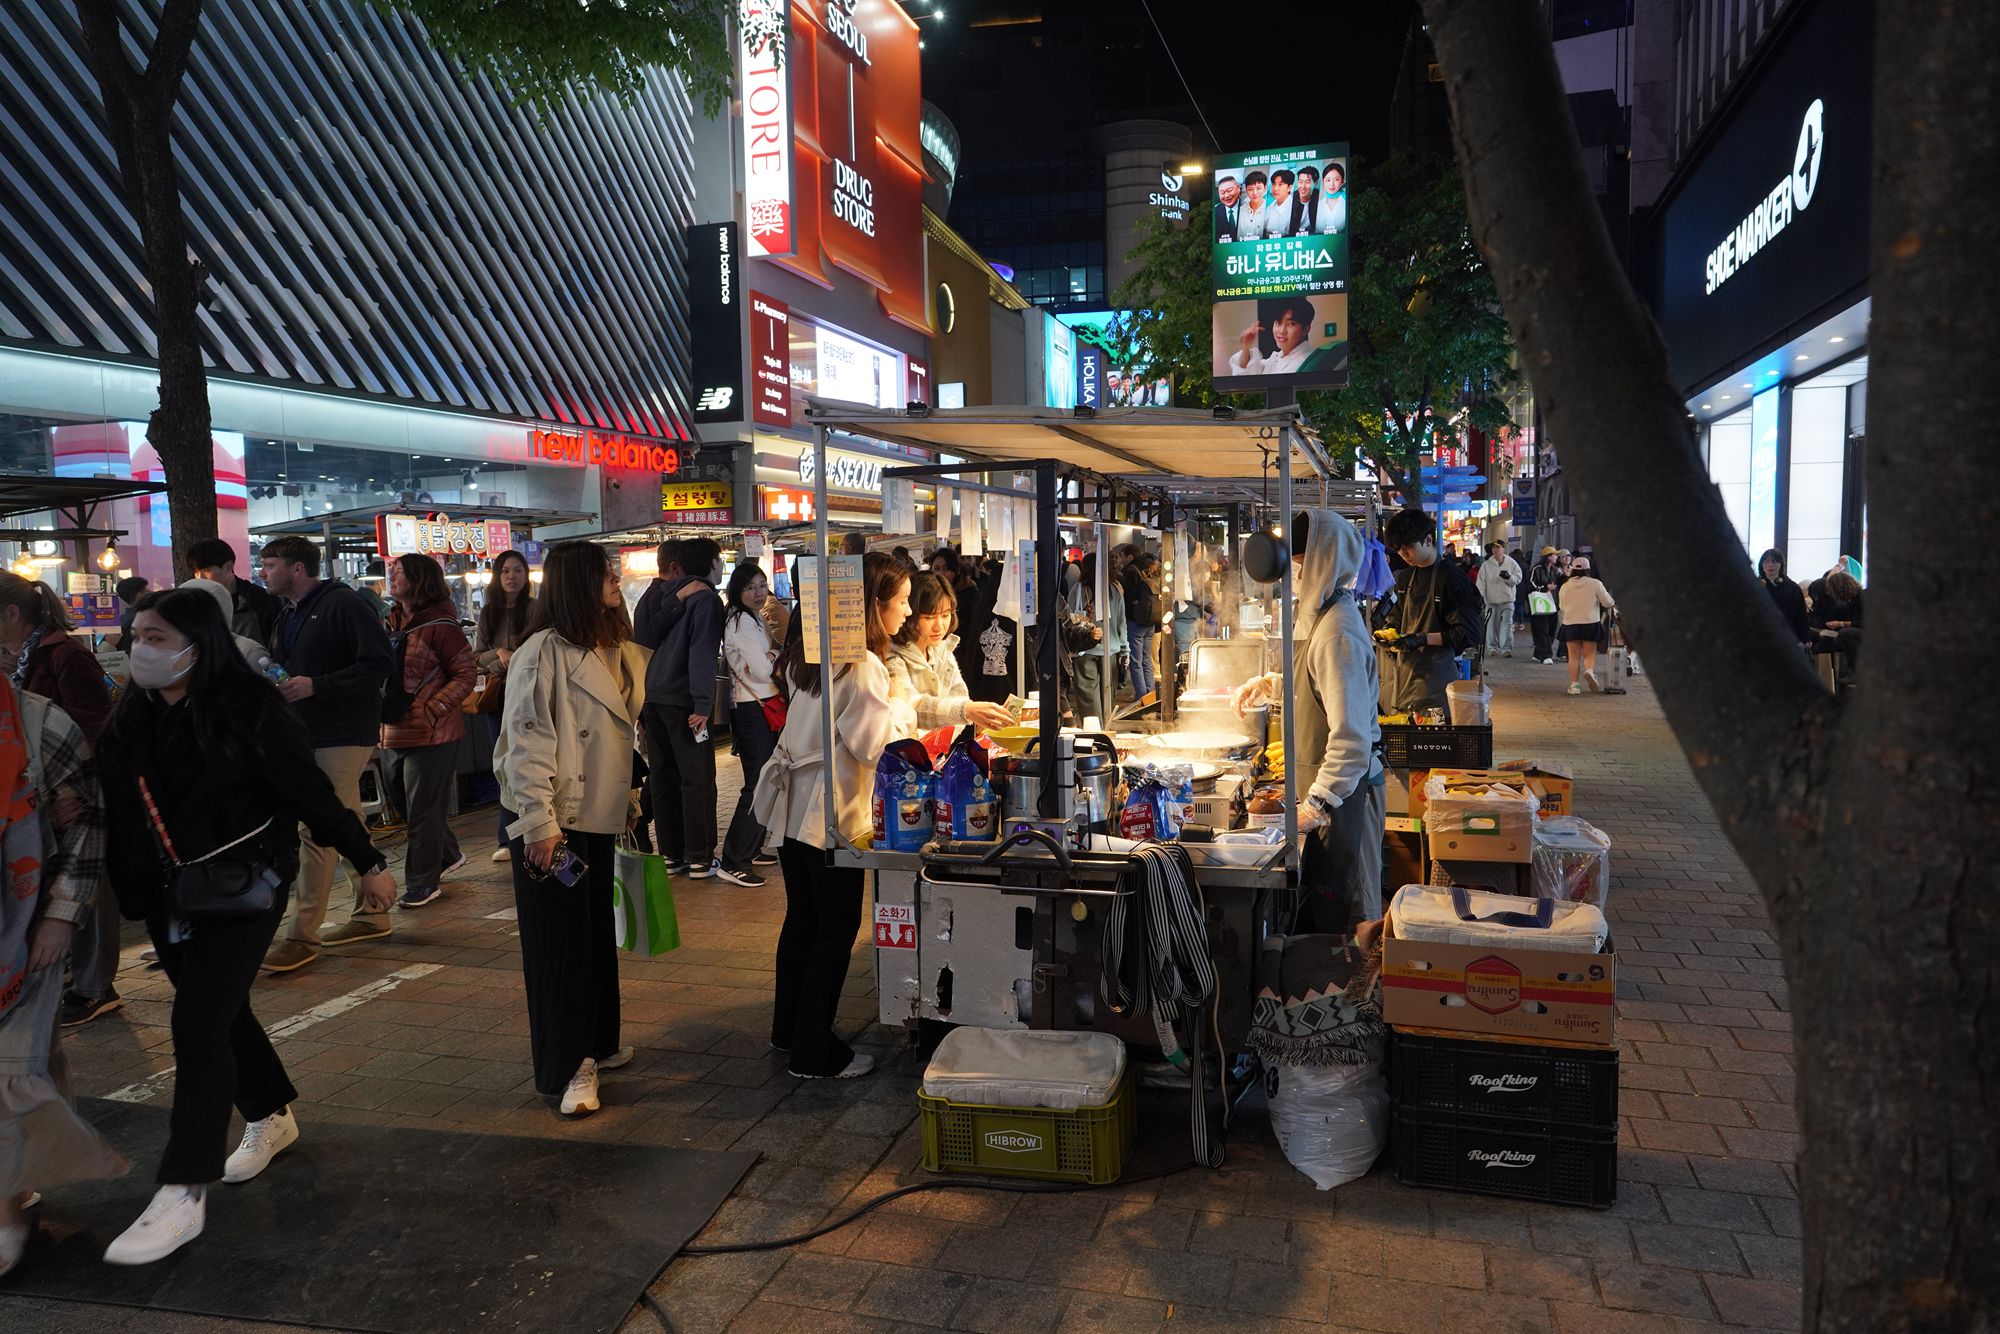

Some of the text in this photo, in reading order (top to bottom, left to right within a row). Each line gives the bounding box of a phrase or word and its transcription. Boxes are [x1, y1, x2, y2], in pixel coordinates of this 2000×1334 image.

[828, 2, 872, 66] SEOUL
[834, 158, 873, 207] DRUG
[834, 189, 875, 238] STORE
[1149, 193, 1190, 211] Shinhan
[750, 199, 785, 237] 藥
[1705, 174, 1793, 296] SHOE MARKER
[720, 227, 730, 305] new balance
[1226, 248, 1334, 275] 하나 유니버스
[1083, 356, 1095, 404] HOLIKA
[531, 430, 679, 474] new balance
[836, 456, 882, 492] SEOUL
[673, 491, 727, 507] 설렁탕
[431, 525, 486, 550] 닭강정
[879, 907, 910, 920] 소화기
[1468, 985, 1518, 1001] Sumifru
[1554, 1018, 1601, 1034] Sumifru
[1469, 1074, 1538, 1091] Roofking
[989, 1135, 1037, 1148] HIBROW
[1467, 1149, 1537, 1166] Roofking
